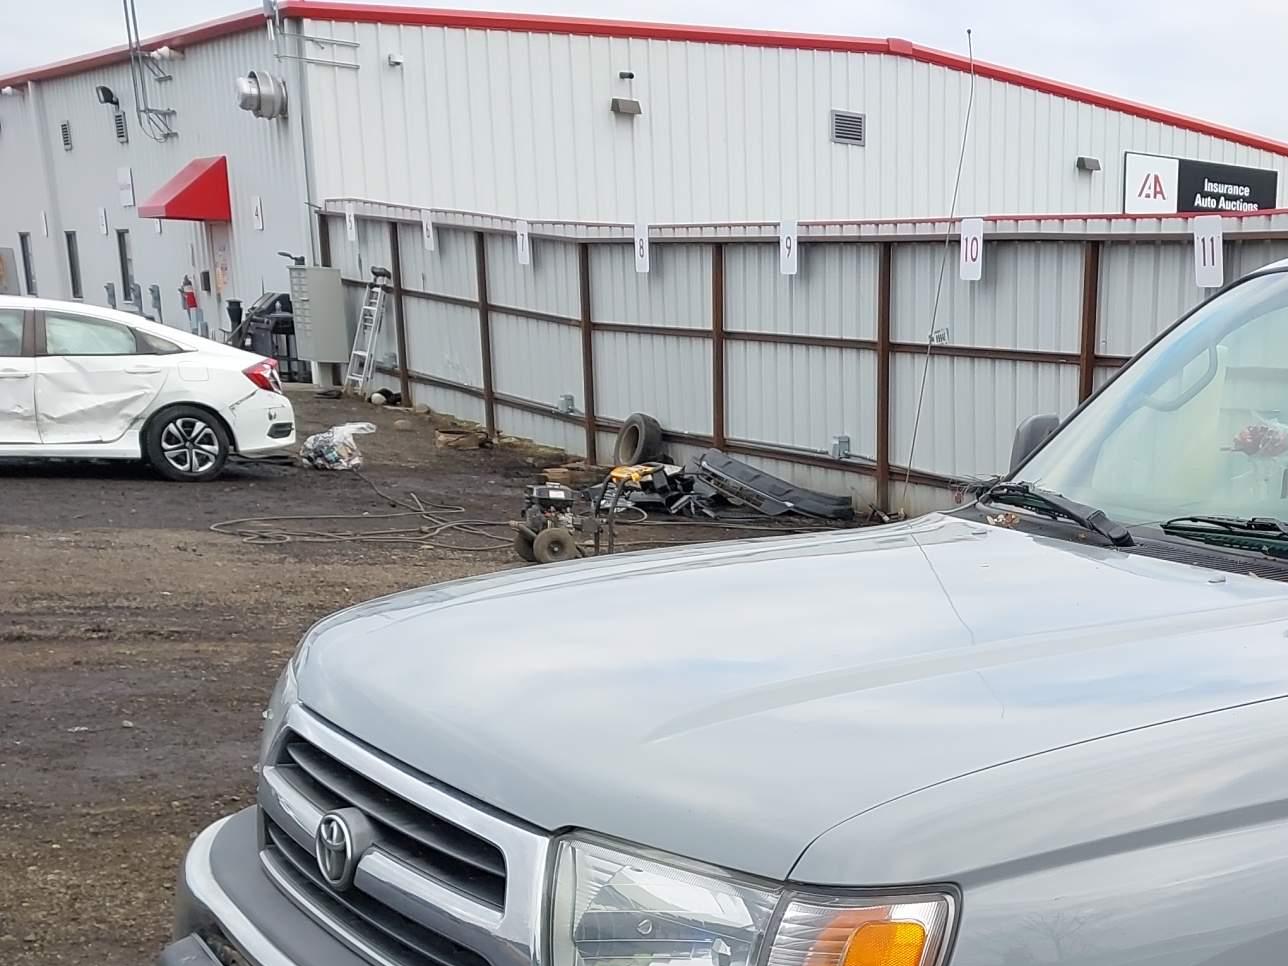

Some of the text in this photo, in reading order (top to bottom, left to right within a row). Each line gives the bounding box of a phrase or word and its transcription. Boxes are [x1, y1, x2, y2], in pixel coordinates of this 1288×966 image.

[1204, 178, 1250, 197] Insurance
[1194, 194, 1259, 212] Auto Auctions
[348, 214, 353, 230] 5
[425, 222, 431, 239] 6
[519, 233, 525, 253] 7
[638, 238, 645, 258] 8
[785, 236, 792, 258] 9
[964, 236, 979, 262] 10
[1201, 236, 1215, 267] 11
